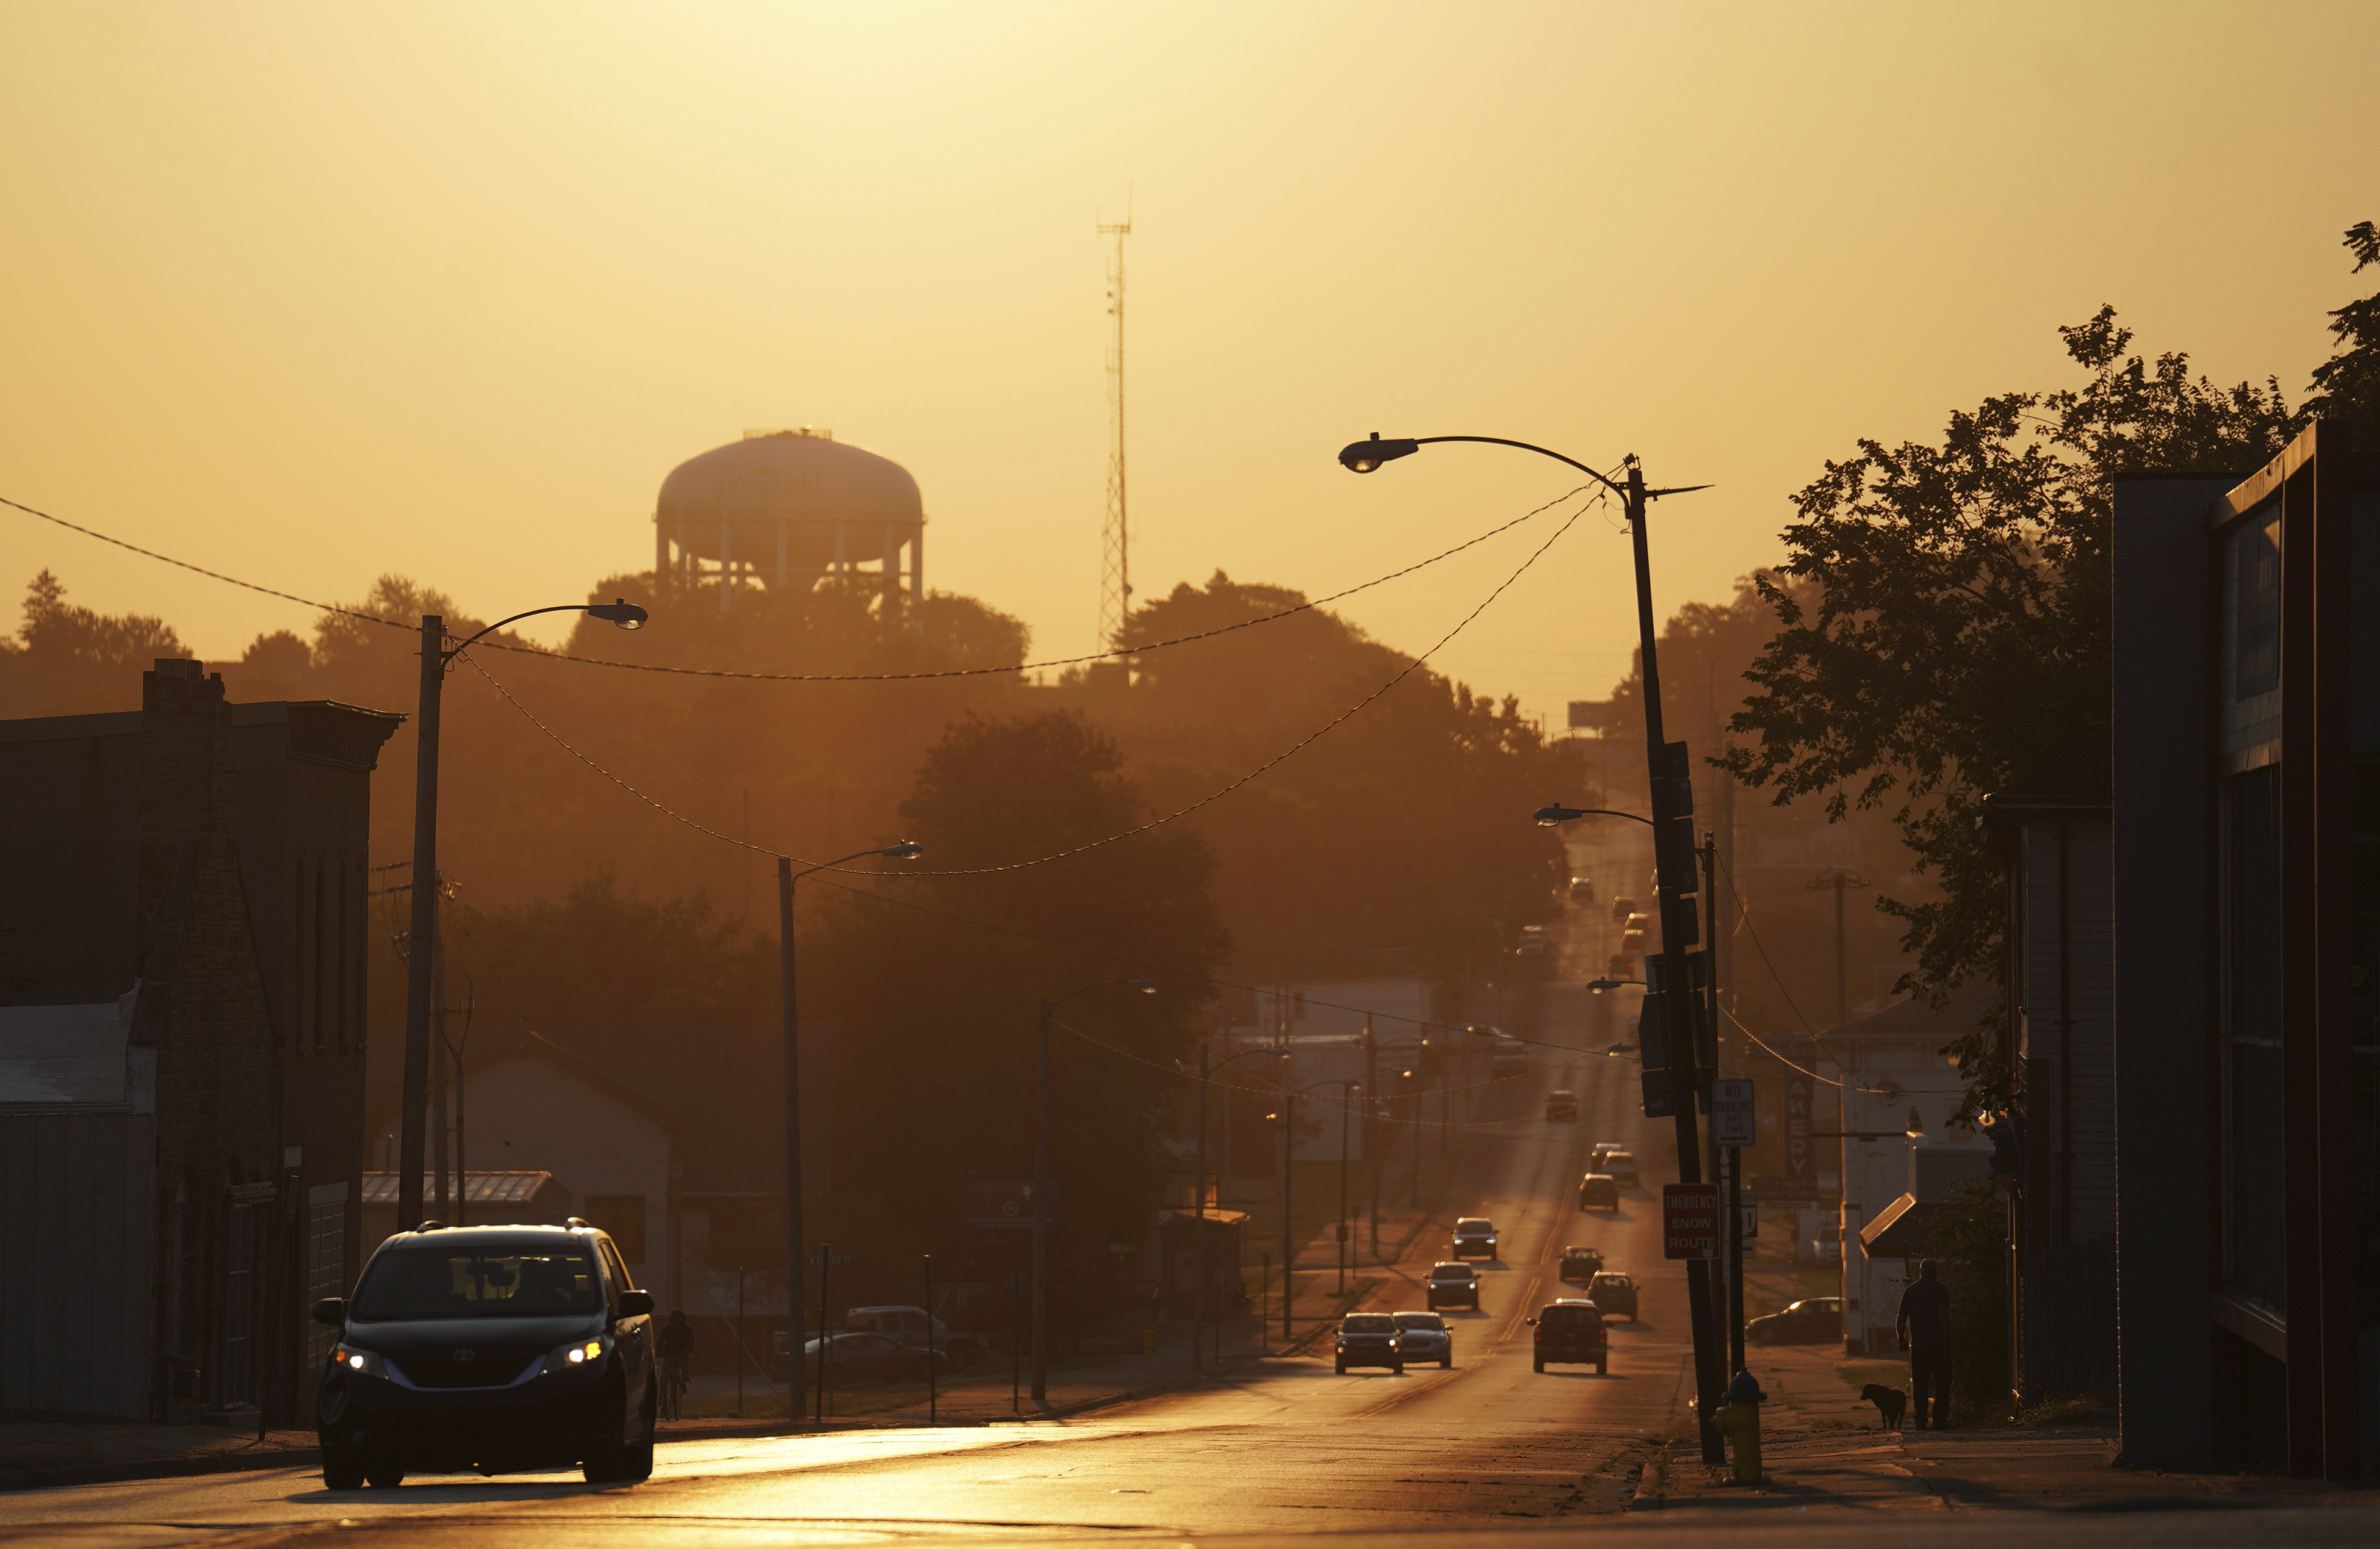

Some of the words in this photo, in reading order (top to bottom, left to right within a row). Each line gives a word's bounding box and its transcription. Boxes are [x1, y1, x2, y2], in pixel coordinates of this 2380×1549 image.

[1725, 1085, 1740, 1097] NO
[1715, 1101, 1751, 1114] PARKING
[1726, 1114, 1742, 1124] ANY
[1789, 1060, 1806, 1175] BAKERY
[1725, 1124, 1744, 1133] TIME
[1666, 1194, 1717, 1210] EMERGENCY
[1671, 1218, 1711, 1229] SNOW
[1668, 1237, 1716, 1249] ROUTE
